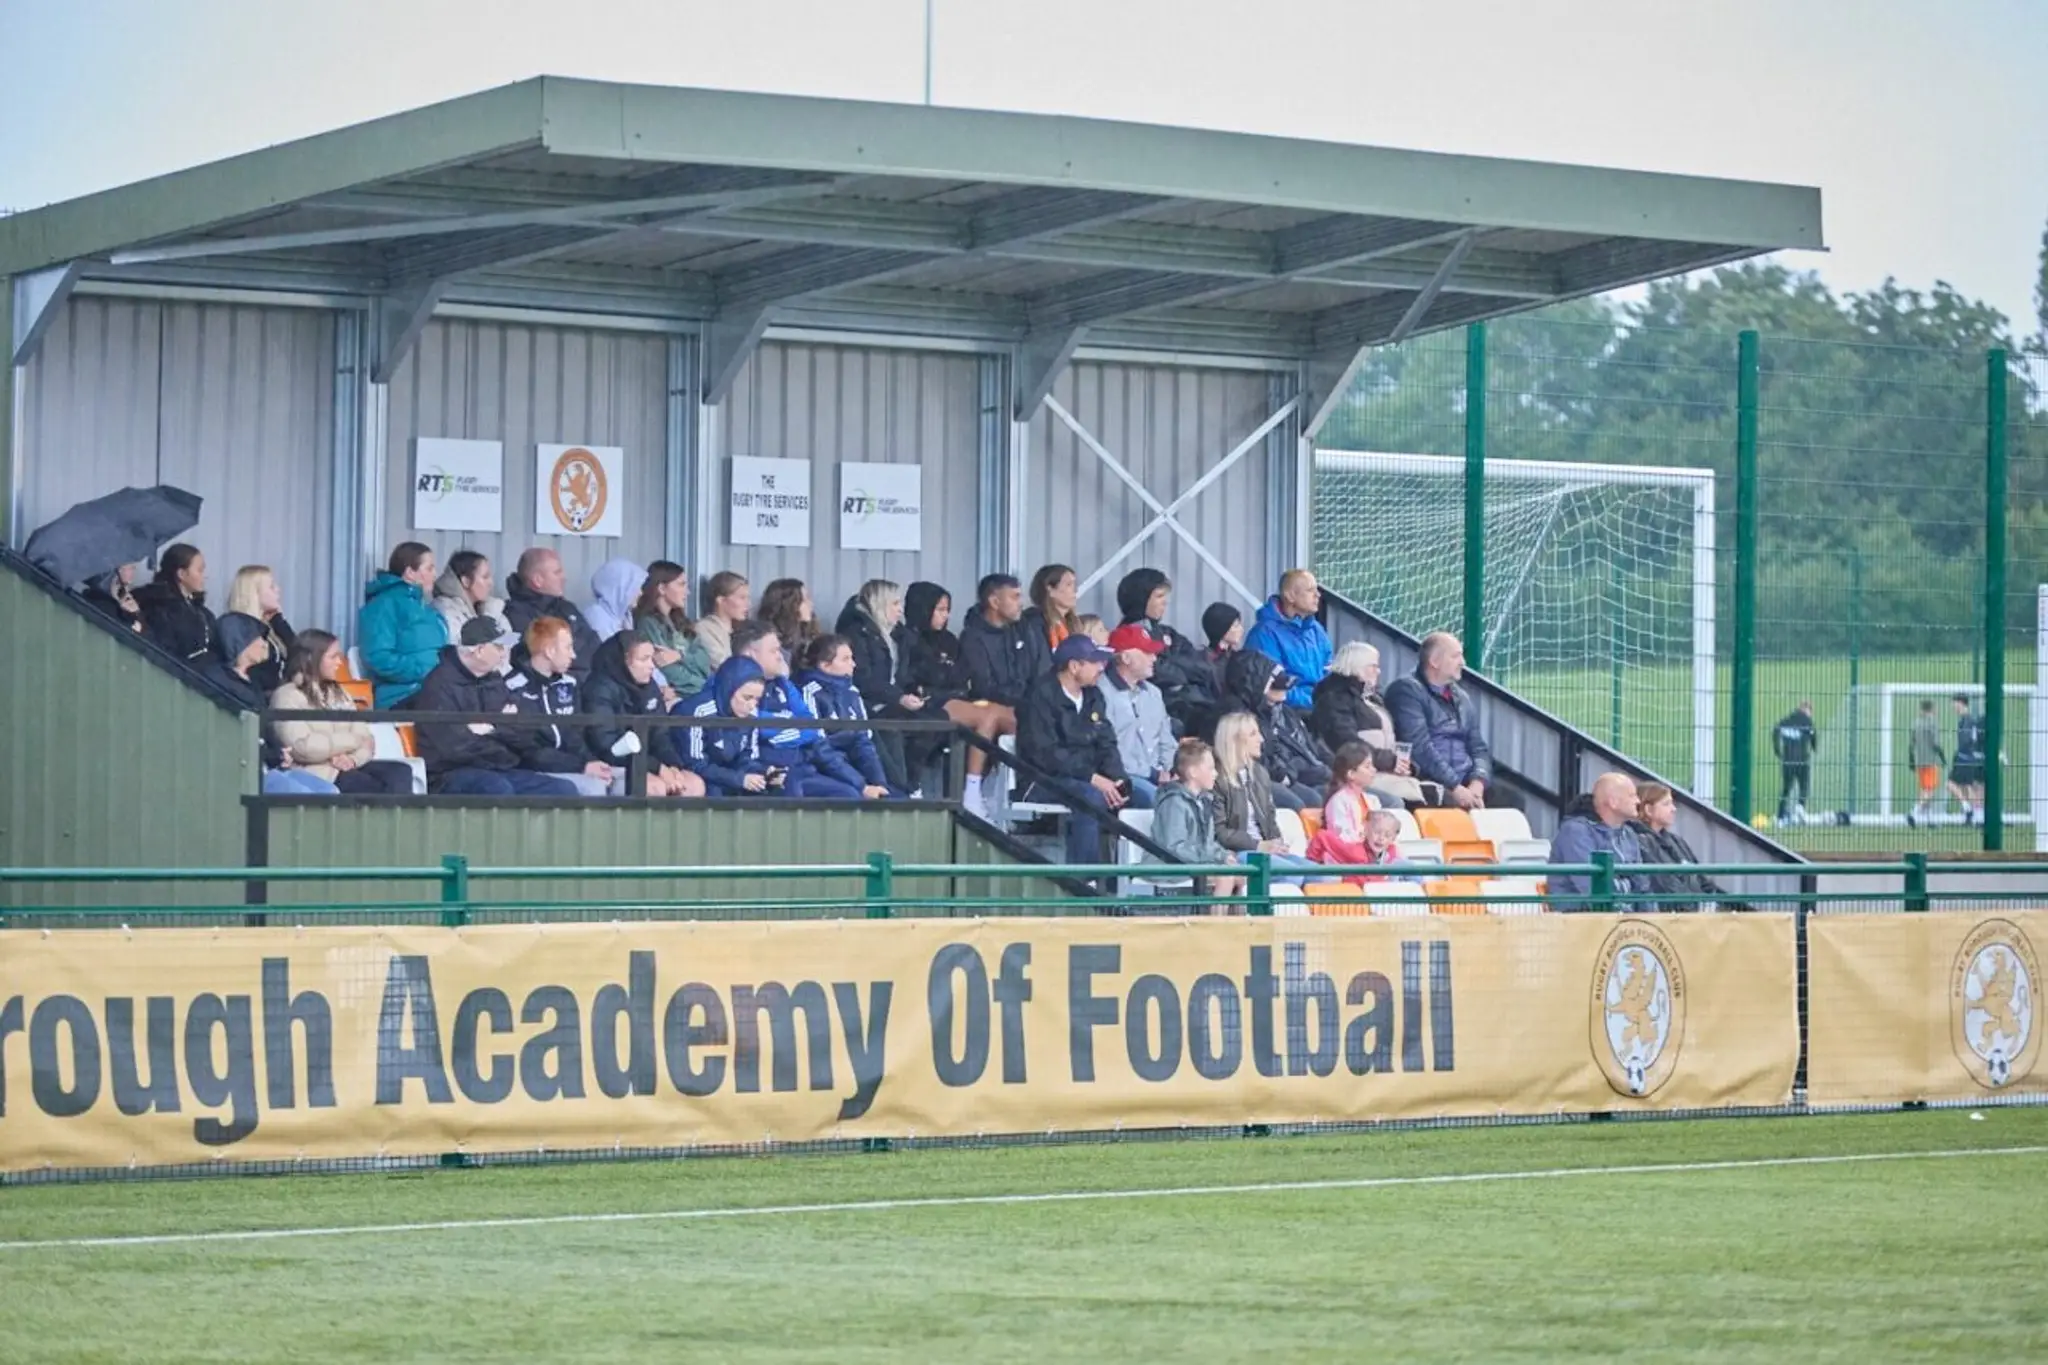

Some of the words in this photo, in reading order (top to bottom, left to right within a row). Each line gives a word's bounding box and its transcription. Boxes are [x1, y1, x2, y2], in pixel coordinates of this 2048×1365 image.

[417, 473, 454, 492] RTS
[761, 474, 776, 489] THE
[774, 494, 808, 510] SERVICES
[843, 496, 876, 514] RTS
[756, 512, 779, 528] STAND
[374, 949, 894, 1121] Academy
[927, 942, 1032, 1087] Of
[1068, 940, 1455, 1084] Football
